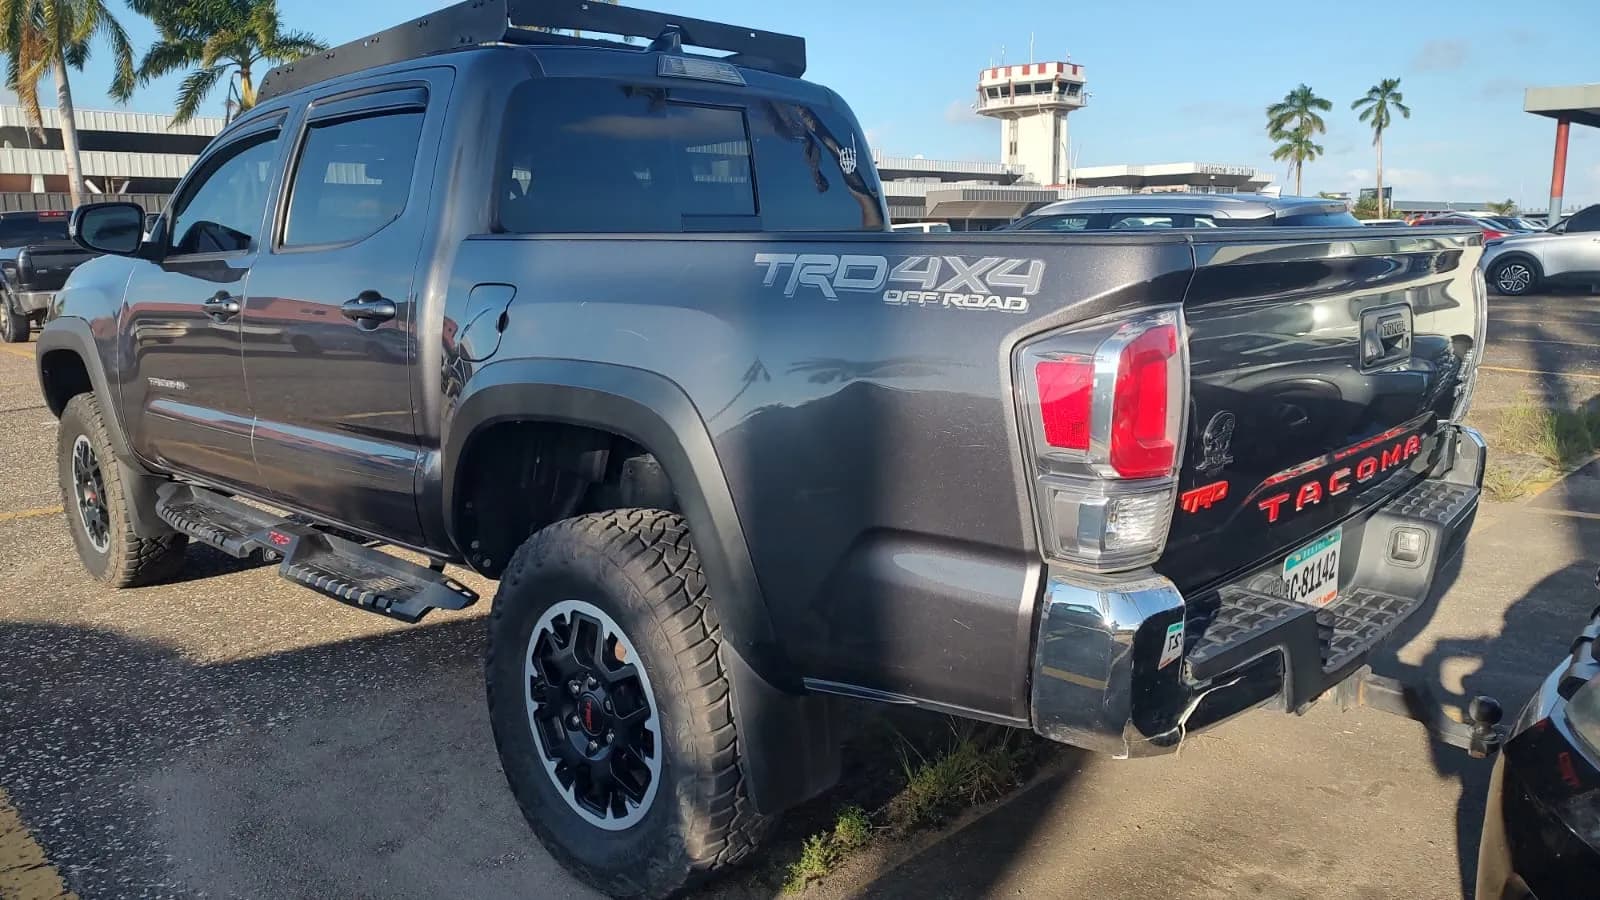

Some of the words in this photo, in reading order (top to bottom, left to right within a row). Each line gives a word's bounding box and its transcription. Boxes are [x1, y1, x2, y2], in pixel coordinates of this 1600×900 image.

[754, 253, 889, 301] TRD
[883, 289, 942, 307] OFF
[942, 292, 1030, 313] ROAD
[1181, 480, 1229, 513] TRD
[1259, 434, 1422, 523] TACOMA
